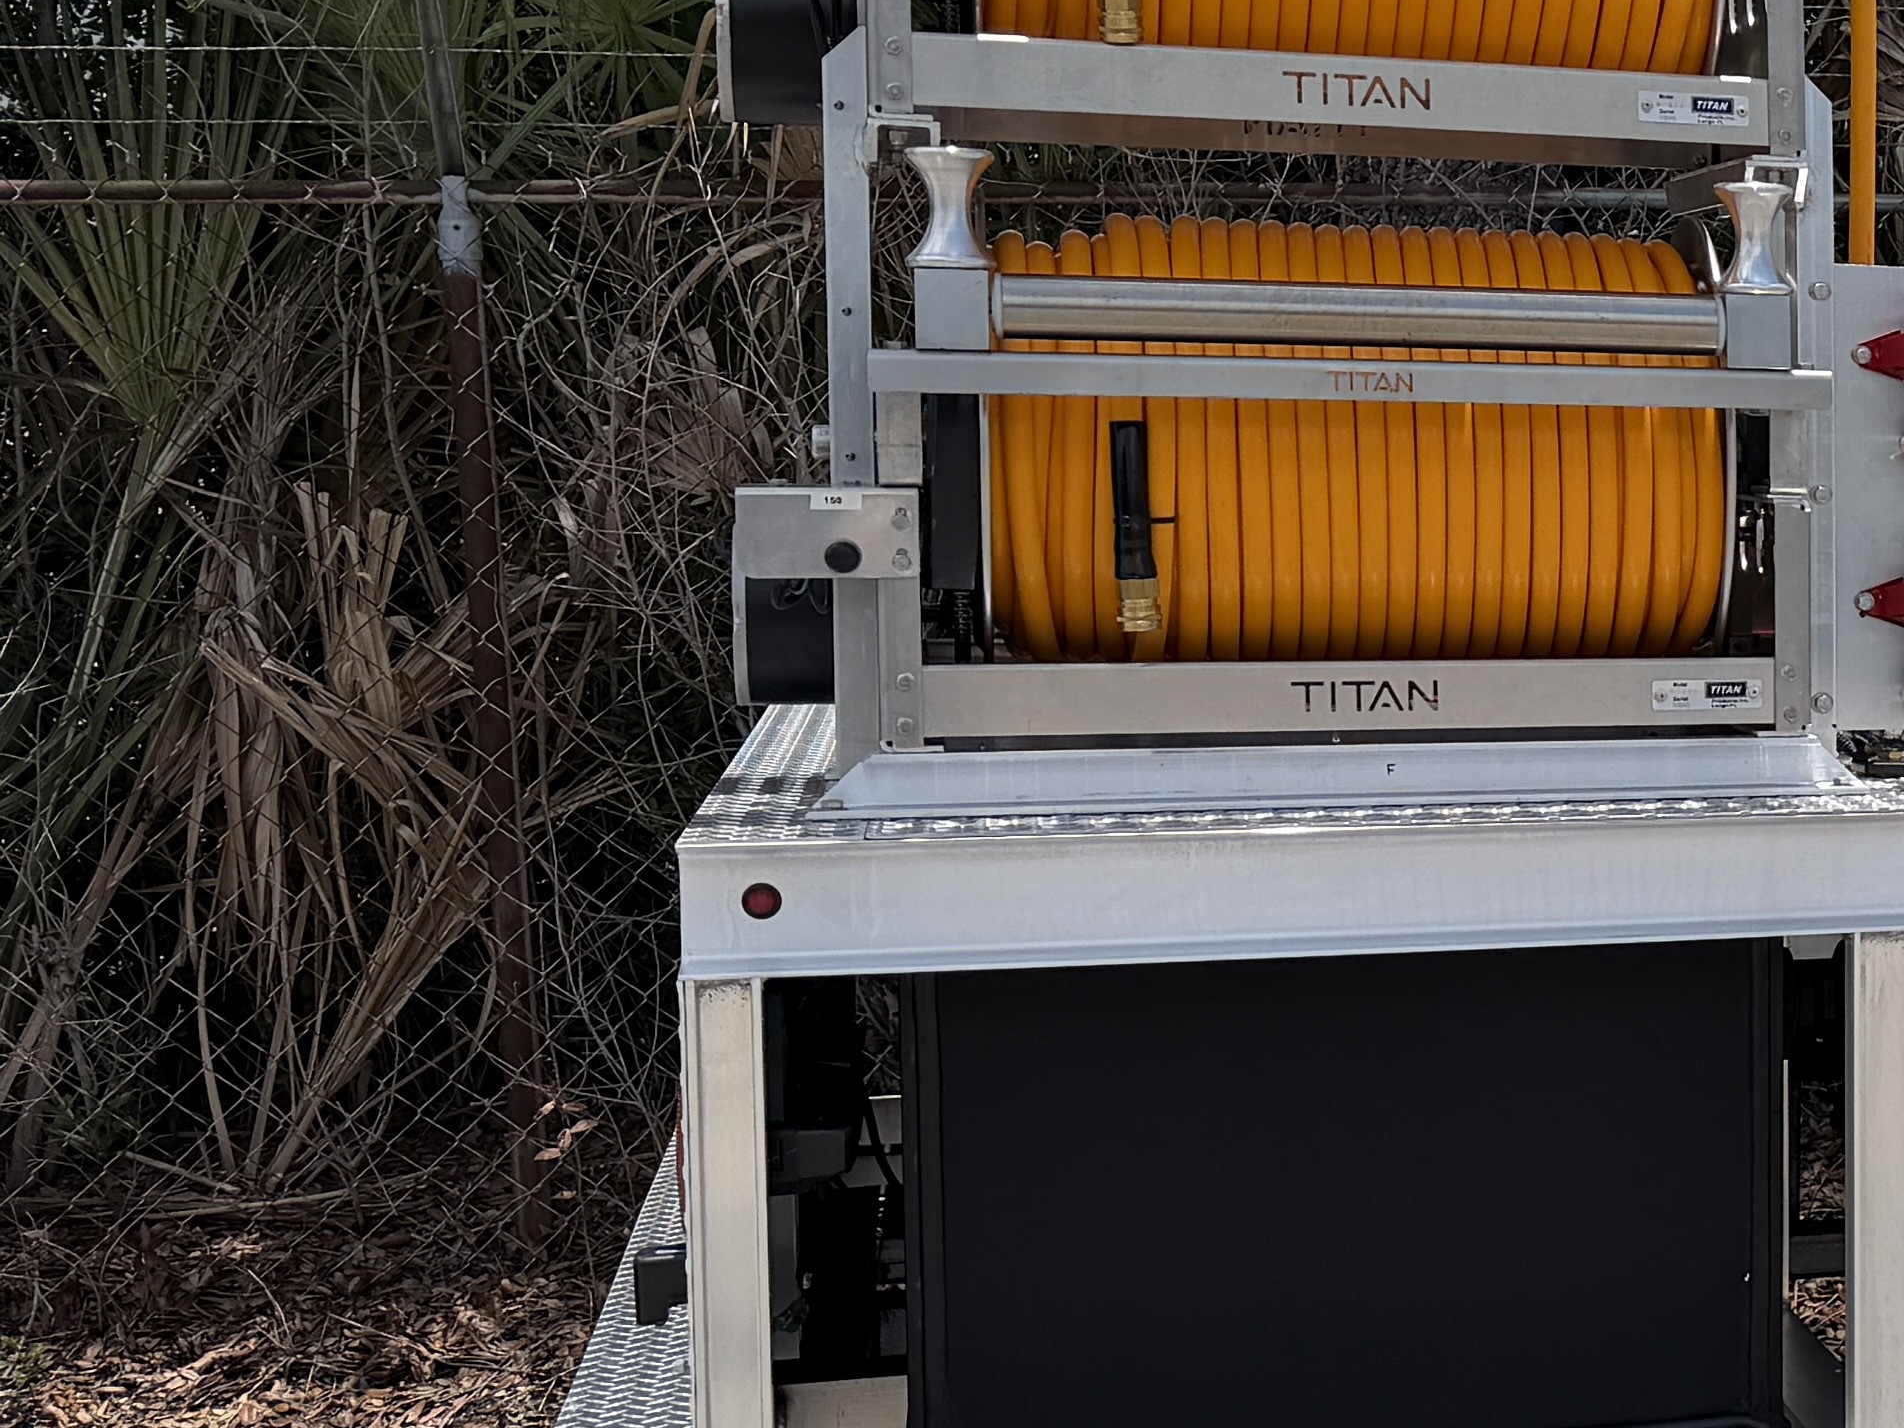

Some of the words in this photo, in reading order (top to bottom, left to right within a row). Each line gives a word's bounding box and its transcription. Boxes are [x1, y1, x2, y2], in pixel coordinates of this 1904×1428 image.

[1282, 70, 1431, 110] TITAN
[1697, 101, 1728, 111] TITAN
[1326, 370, 1414, 393] TITAN
[1291, 680, 1438, 712] TITAN
[1711, 685, 1742, 694] TITAN
